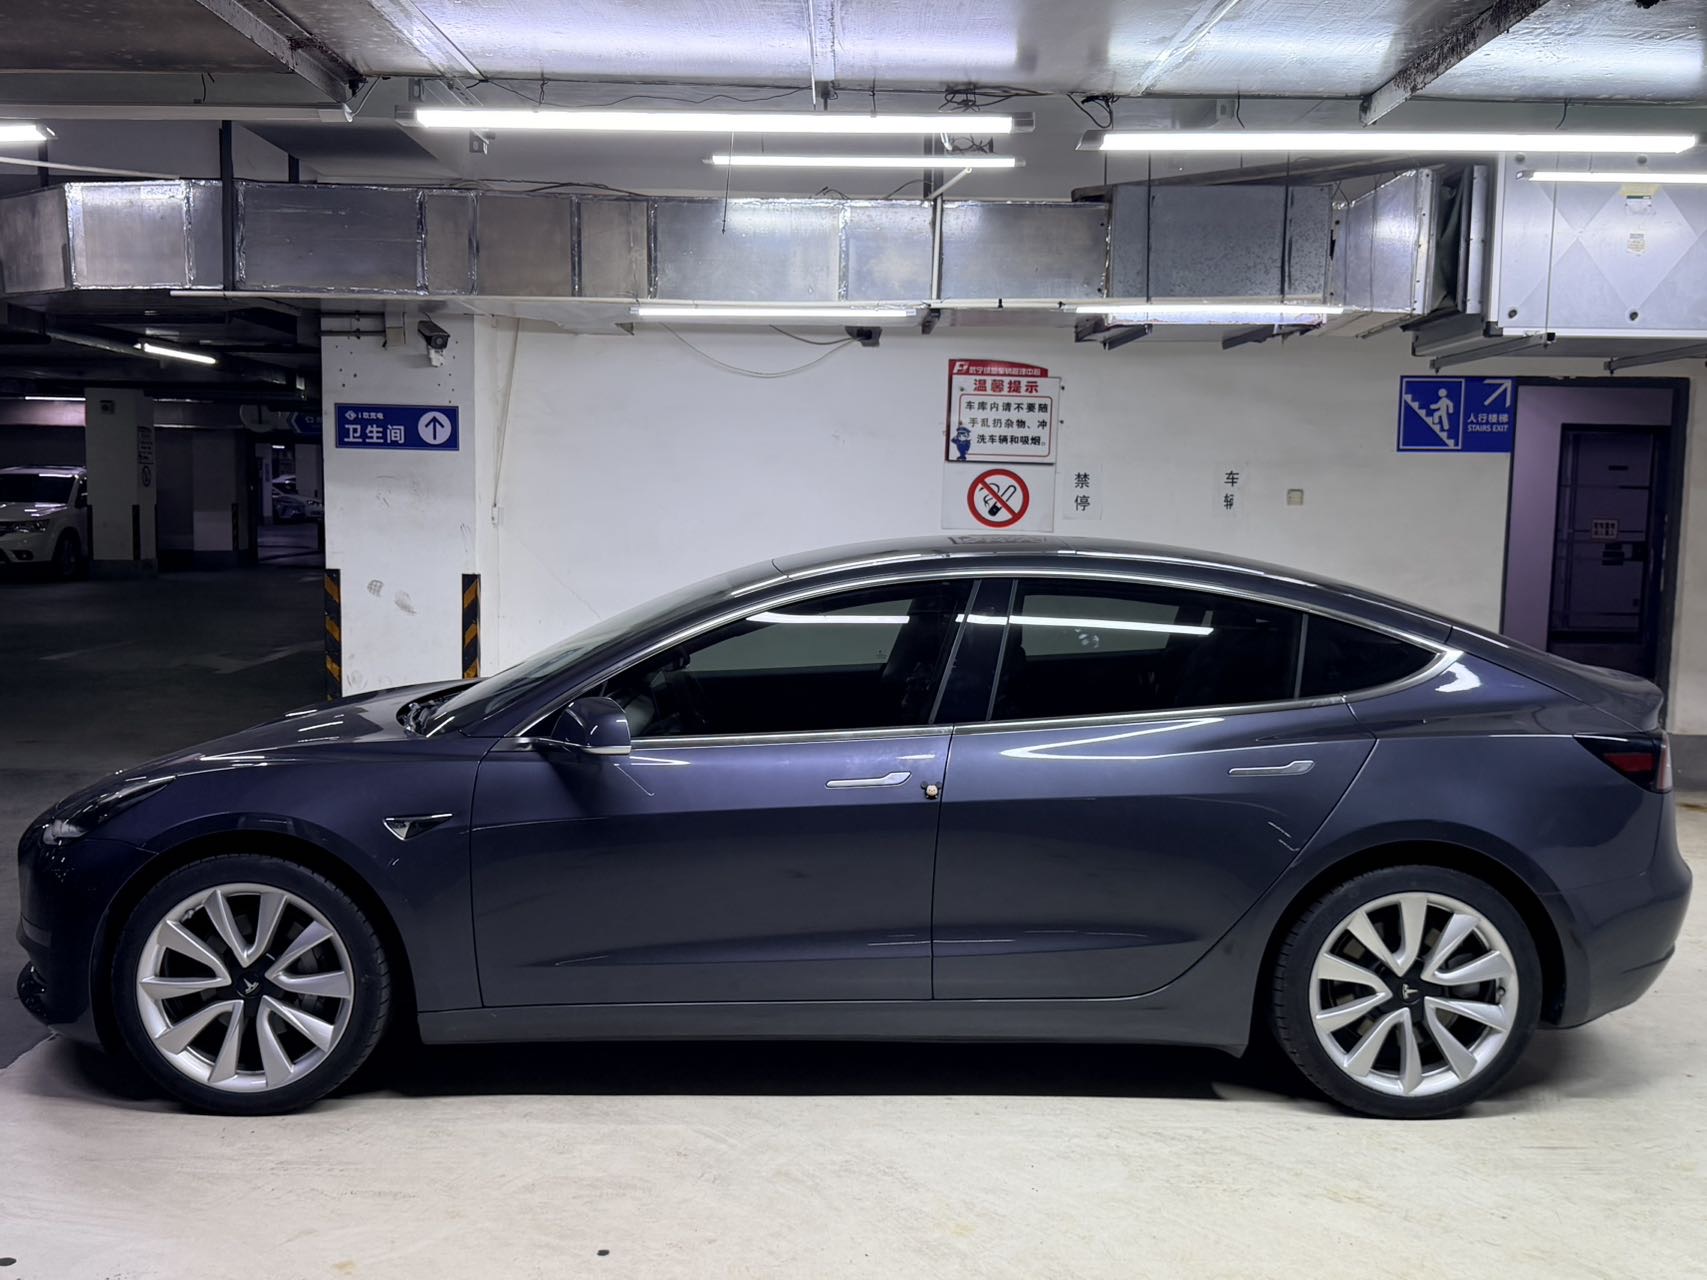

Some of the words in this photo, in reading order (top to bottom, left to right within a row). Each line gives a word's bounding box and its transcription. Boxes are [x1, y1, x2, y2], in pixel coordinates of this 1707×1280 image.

[973, 378, 1040, 394] 温馨提示
[965, 400, 1049, 414] 车库内请不要随
[968, 417, 1048, 431] 手乱扔杂物、冲
[1467, 424, 1491, 432] STAIRS
[1492, 424, 1509, 432] EXIT
[343, 424, 405, 444] 卫生间
[1074, 472, 1091, 512] 禁停
